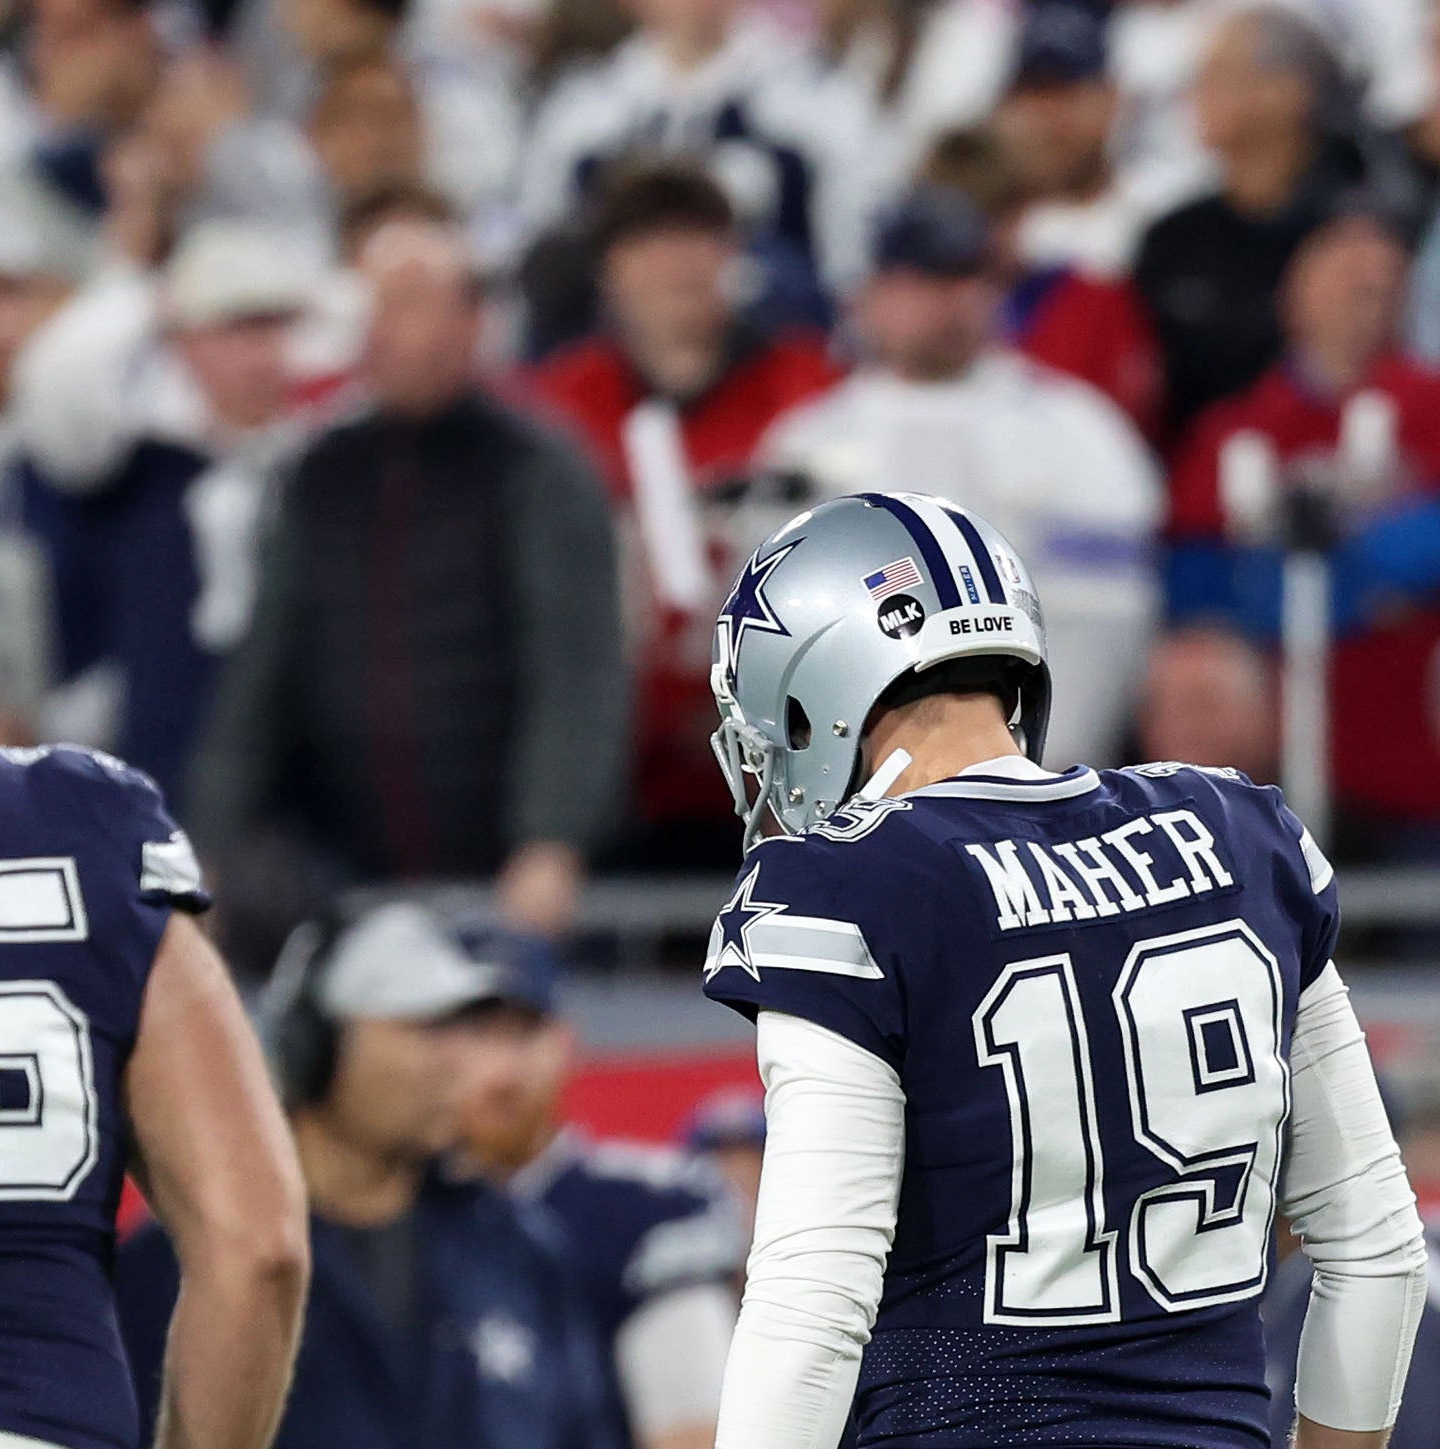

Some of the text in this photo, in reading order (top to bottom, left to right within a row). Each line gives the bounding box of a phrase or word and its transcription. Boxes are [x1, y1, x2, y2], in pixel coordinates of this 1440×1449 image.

[879, 602, 922, 633] MLK
[949, 617, 1012, 635] BE LOVE
[965, 809, 1234, 931] MAHER
[972, 918, 1290, 1326] 19
